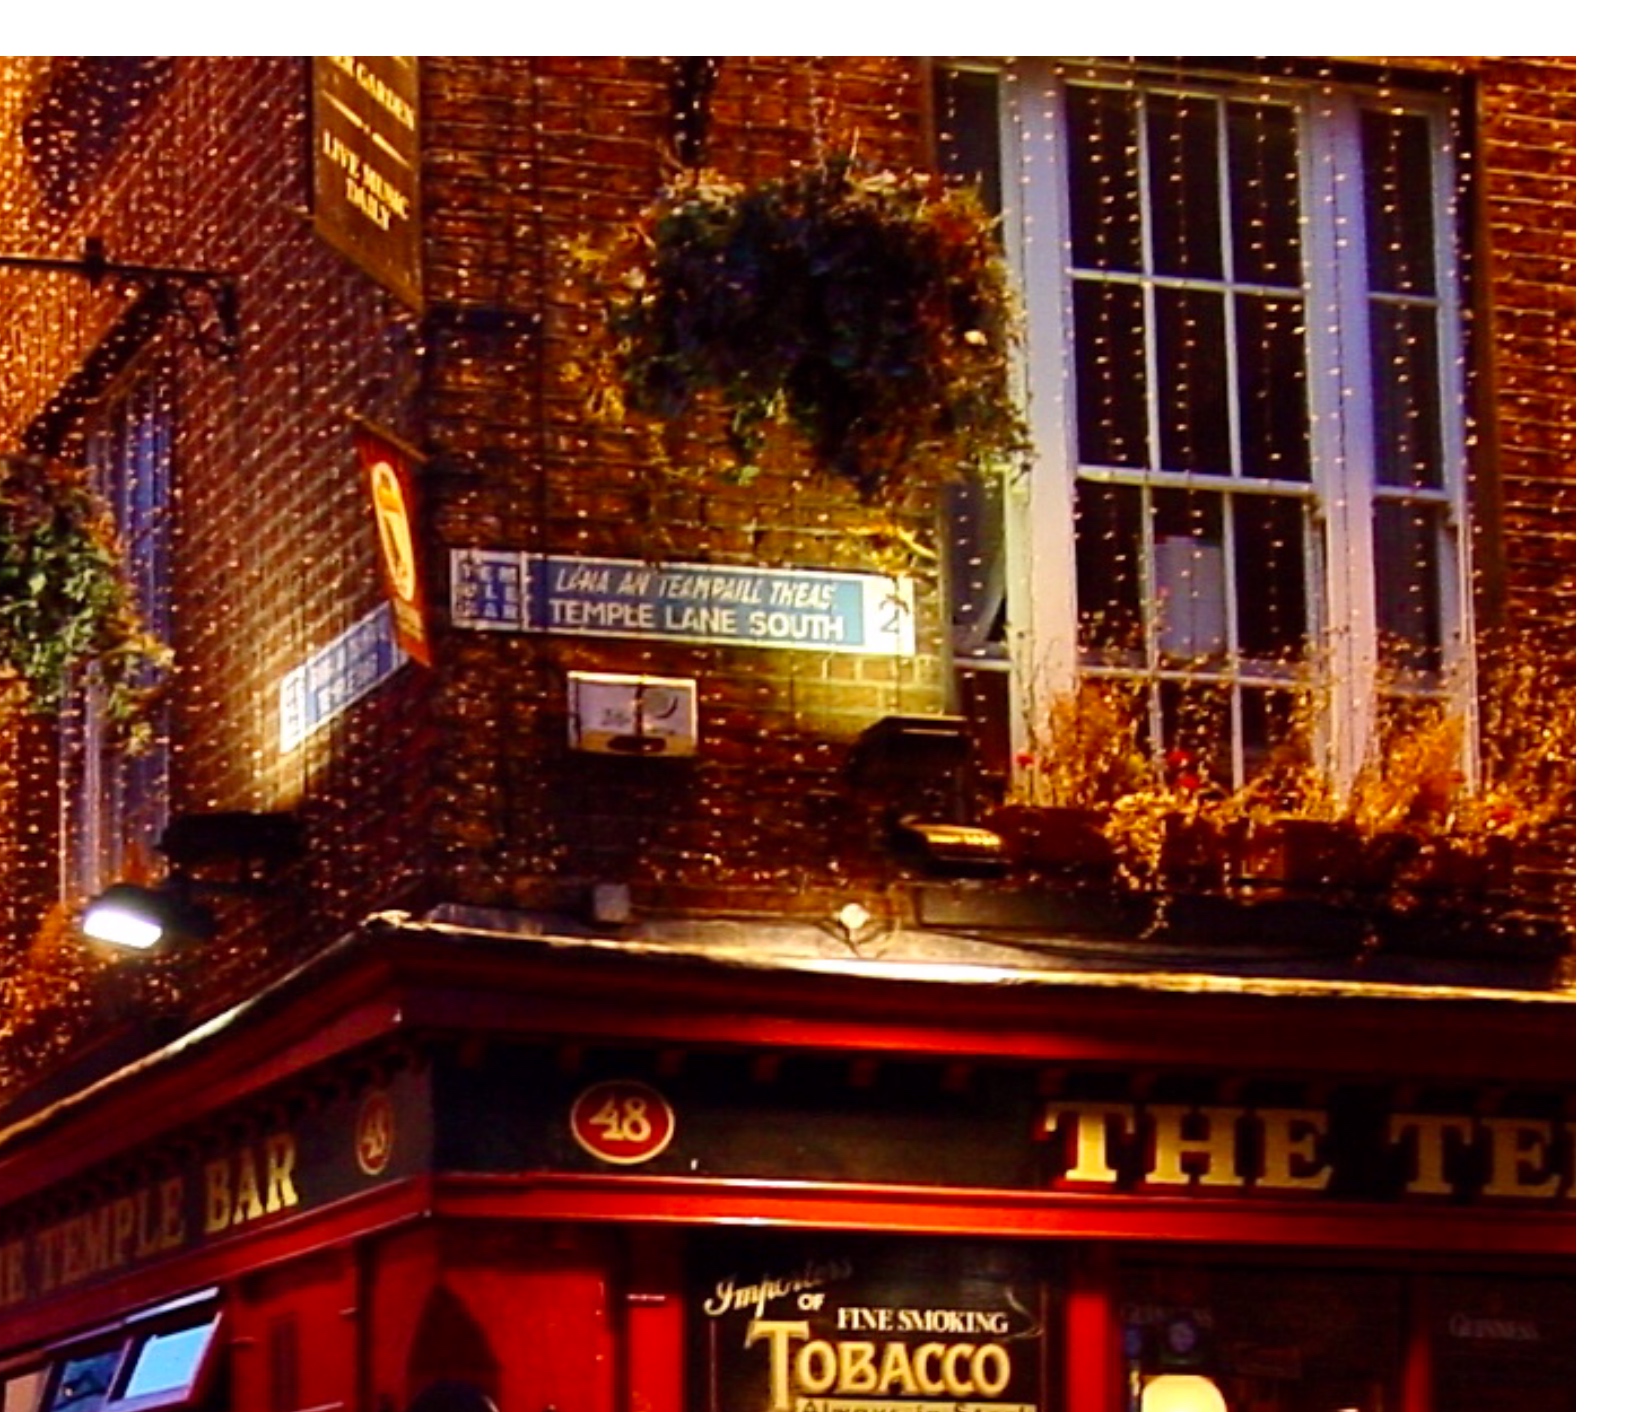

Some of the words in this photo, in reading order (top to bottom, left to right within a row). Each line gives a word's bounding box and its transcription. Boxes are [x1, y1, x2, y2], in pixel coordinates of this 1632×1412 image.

[323, 129, 360, 179] LIVE
[362, 163, 410, 221] MUSIC
[346, 176, 390, 231] DAILY
[549, 599, 655, 628] TEMPLE
[665, 606, 738, 635] LANE
[749, 611, 845, 641] SOUTH
[878, 597, 903, 635] 2
[589, 1093, 652, 1142] 48
[1043, 1102, 1334, 1189] THE
[1390, 1114, 1576, 1198] TE
[36, 1176, 185, 1293] TEMPLE
[203, 1132, 299, 1233] BAR
[798, 1292, 825, 1311] OF
[837, 1307, 894, 1332] FINE
[897, 1309, 1009, 1334] SMOKING
